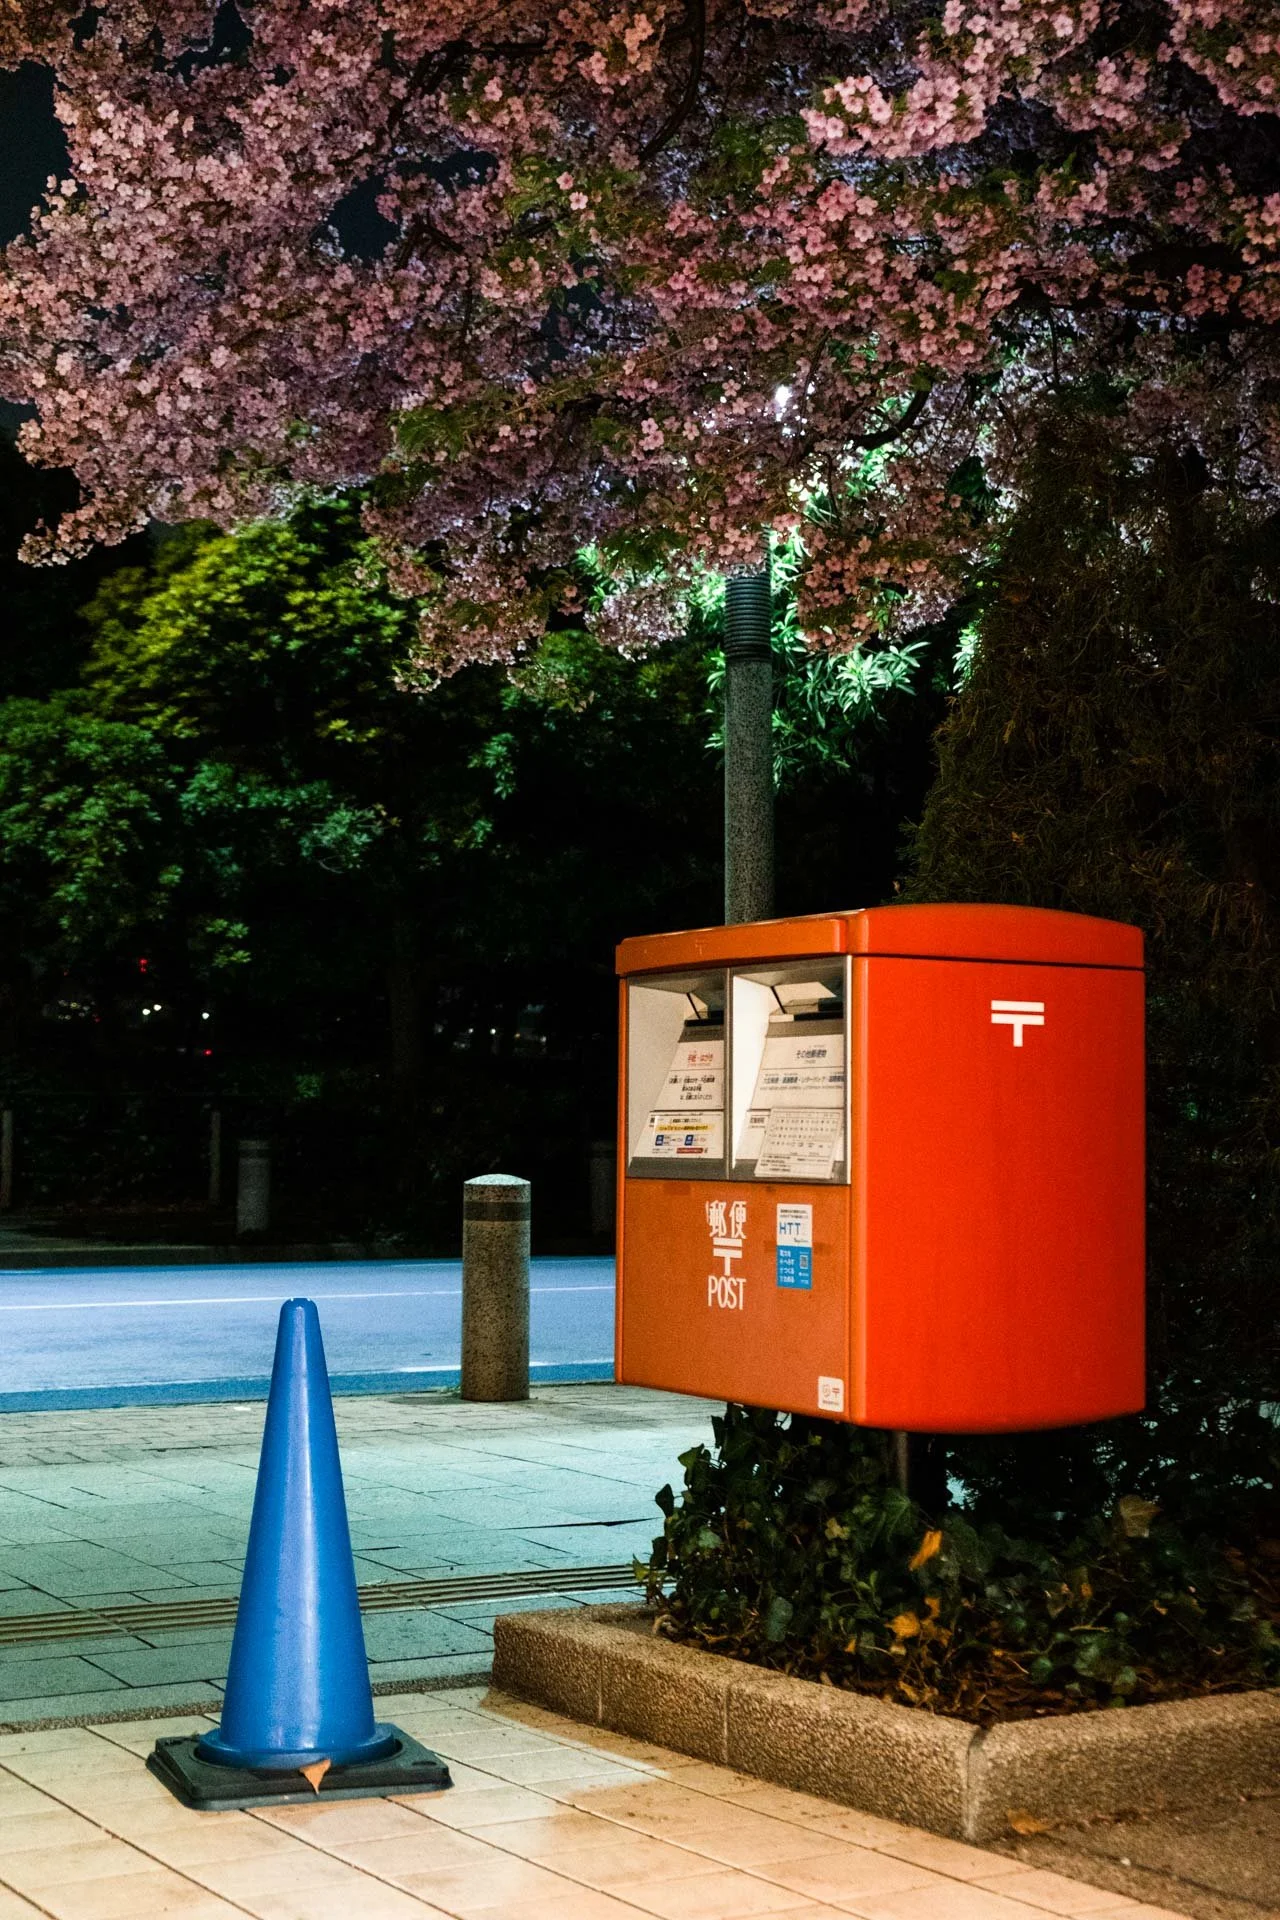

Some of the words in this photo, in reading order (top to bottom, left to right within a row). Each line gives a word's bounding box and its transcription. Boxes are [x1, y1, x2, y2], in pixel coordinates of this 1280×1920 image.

[705, 1199, 747, 1240] 郵便
[779, 1222, 801, 1236] HTT
[707, 1275, 747, 1310] POST
